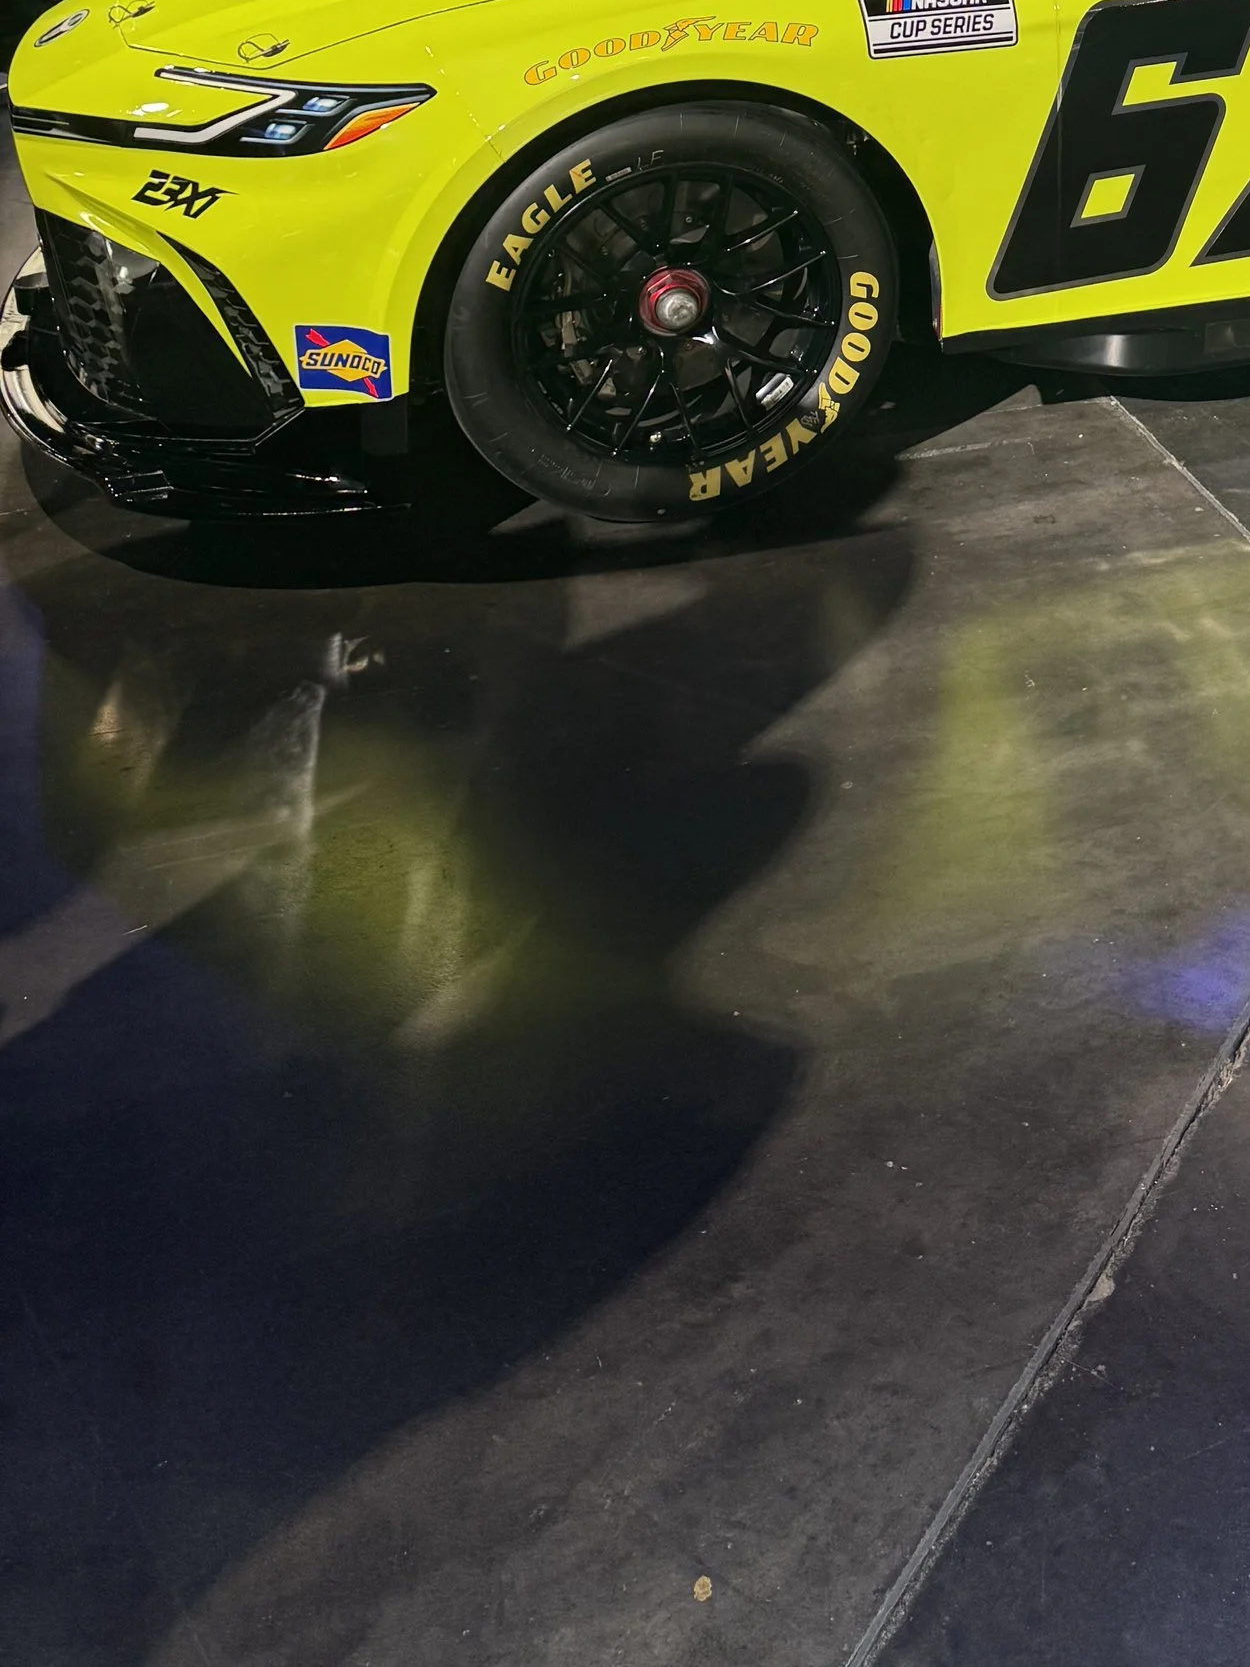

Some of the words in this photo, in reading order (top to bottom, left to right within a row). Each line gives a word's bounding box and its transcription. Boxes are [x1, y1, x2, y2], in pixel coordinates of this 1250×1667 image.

[890, 20, 927, 40] CUP
[930, 14, 995, 36] SERIES
[485, 158, 597, 292] EAGLE
[305, 351, 382, 375] SUNOCO
